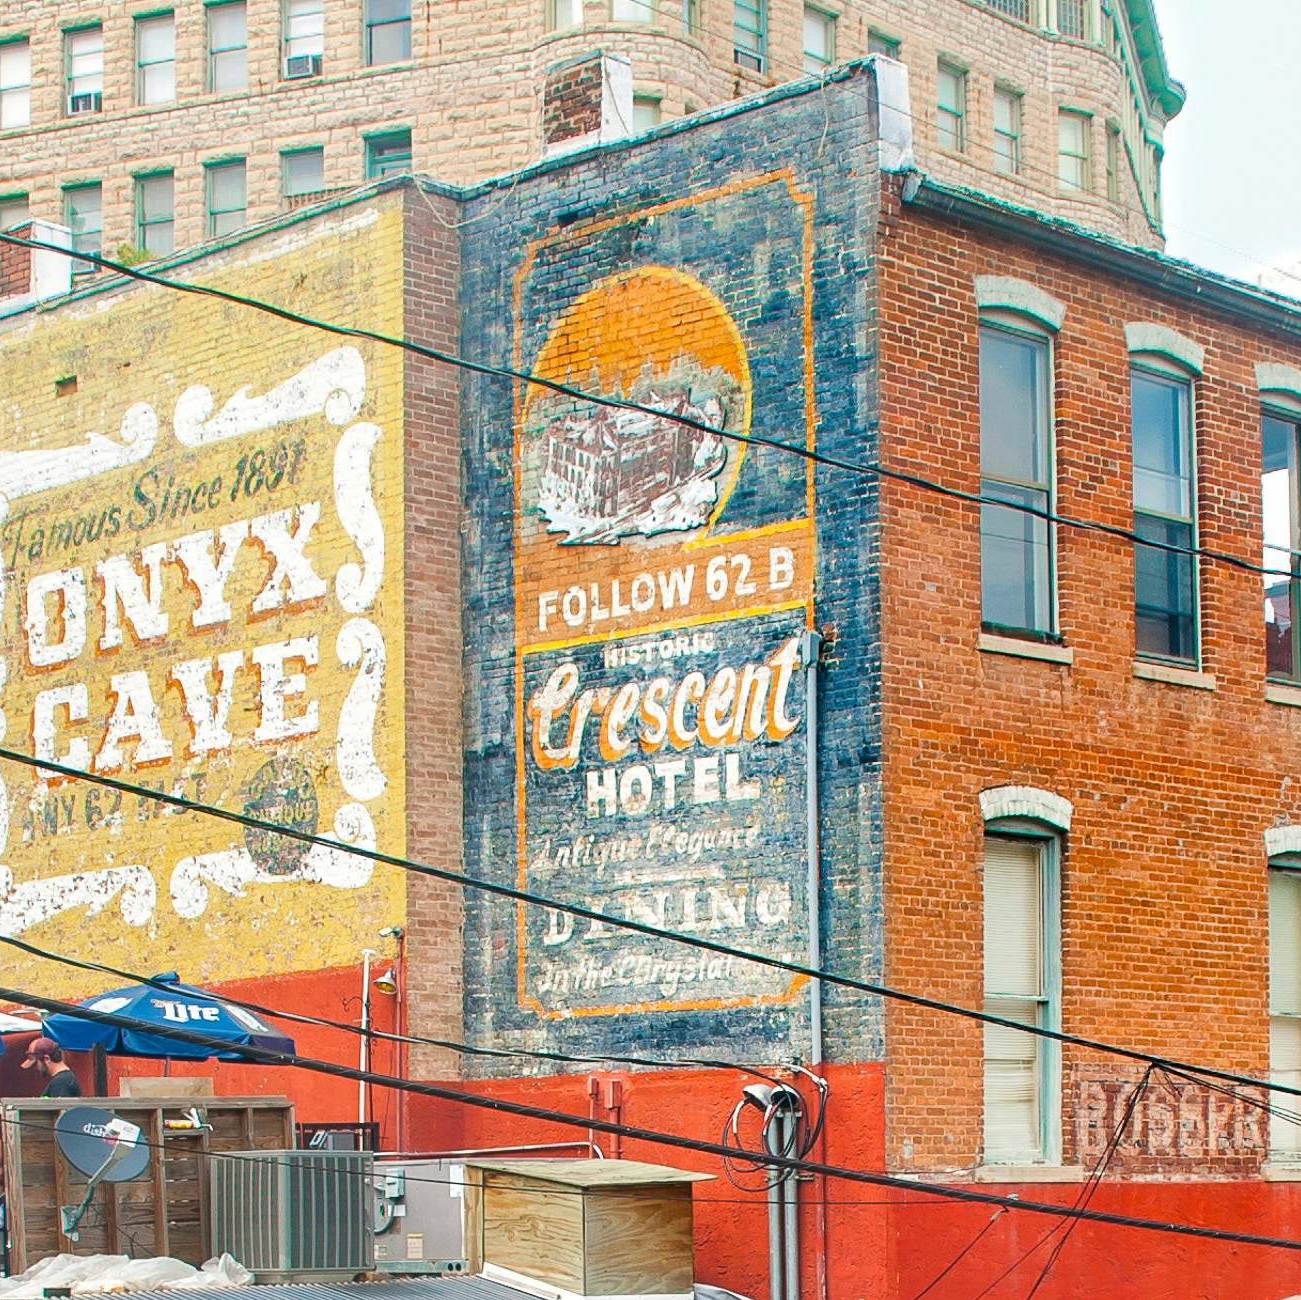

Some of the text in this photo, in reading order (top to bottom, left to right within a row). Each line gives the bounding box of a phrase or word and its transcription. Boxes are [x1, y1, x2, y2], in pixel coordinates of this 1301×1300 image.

[0, 500, 121, 567] Famous
[126, 465, 223, 531] Since
[23, 501, 329, 676] ONYX
[538, 547, 795, 632] FOLLOW 62 B
[604, 632, 716, 669] HISTORIC
[28, 636, 320, 783] CAVE
[528, 636, 800, 770] Crescent
[85, 787, 123, 831] 62
[586, 752, 760, 819] HOTEL
[544, 879, 793, 946] DINING
[163, 1002, 221, 1023] Lite
